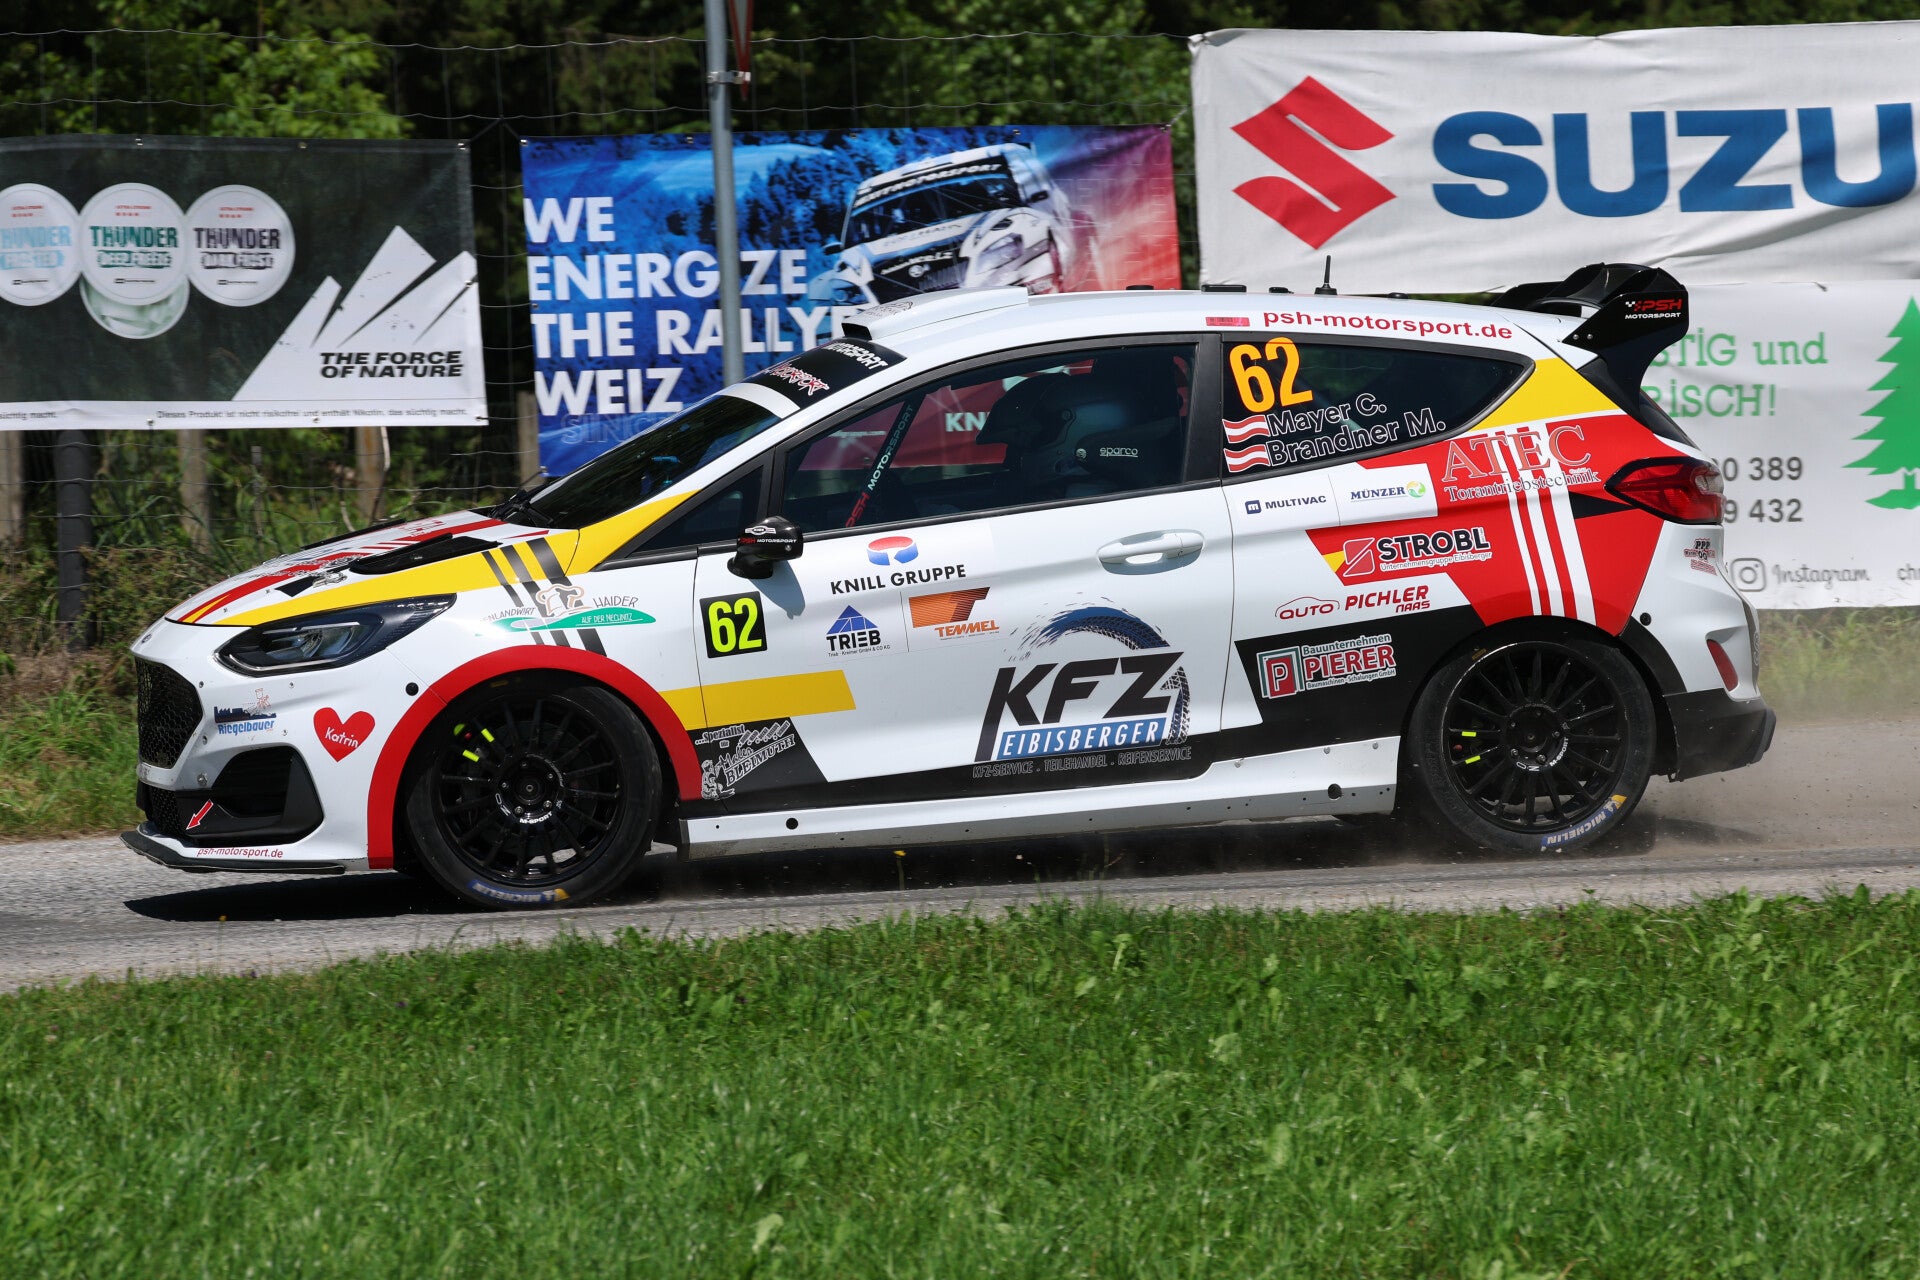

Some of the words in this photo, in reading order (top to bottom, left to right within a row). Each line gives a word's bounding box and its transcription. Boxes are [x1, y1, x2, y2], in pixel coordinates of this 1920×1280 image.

[1432, 102, 1918, 219] SUZU
[523, 197, 616, 243] WE
[89, 225, 178, 248] THUNDER
[194, 227, 280, 250] THUNDER
[527, 249, 808, 300] ENERGZE
[1641, 299, 1682, 311] PSH
[531, 312, 635, 358] THE
[1264, 311, 1514, 340] psh-motorsport.de
[321, 352, 371, 365] THE
[375, 350, 462, 365] FORCE
[1752, 332, 1828, 366] und
[321, 365, 354, 379] OF
[359, 364, 463, 378] NATURE
[1229, 336, 1314, 413] 62
[535, 367, 684, 417] WEIZ
[945, 411, 991, 433] KN
[1267, 403, 1351, 436] Mayer
[1356, 393, 1387, 417] C.
[867, 404, 915, 491] MOTORSPORT
[1266, 421, 1400, 467] Brandner
[1404, 408, 1446, 437] M.
[1099, 447, 1138, 458] sparco
[1441, 424, 1592, 483] ATEC
[1748, 456, 1803, 481] 389
[1265, 495, 1327, 510] MULTIVAC
[1350, 485, 1406, 500] MÜNZER
[1749, 498, 1804, 523] 432
[1377, 527, 1490, 561] STROBL
[830, 575, 886, 595] KNILL
[890, 564, 967, 587] GRUPPE
[593, 595, 639, 608] HAIDER
[1344, 585, 1429, 611] PICHLER
[708, 597, 763, 653] 62
[934, 619, 1000, 638] TEMMEL
[826, 629, 882, 652] TRIEB
[1302, 633, 1392, 656] Bauunternehmen
[1304, 645, 1396, 680] PIERER
[974, 651, 1185, 763] KFZ
[217, 720, 275, 736] Riegelbauer
[325, 726, 359, 749] Katrin
[1002, 720, 1160, 757] EIBISBERGER
[972, 761, 1034, 779] KFZ-SERVICE
[1043, 754, 1109, 772] TEILEHANDEL
[1117, 746, 1192, 766] REIFENSERVICE
[1546, 811, 1608, 845] MICHELIN
[196, 846, 284, 859] psh-motorsport.de
